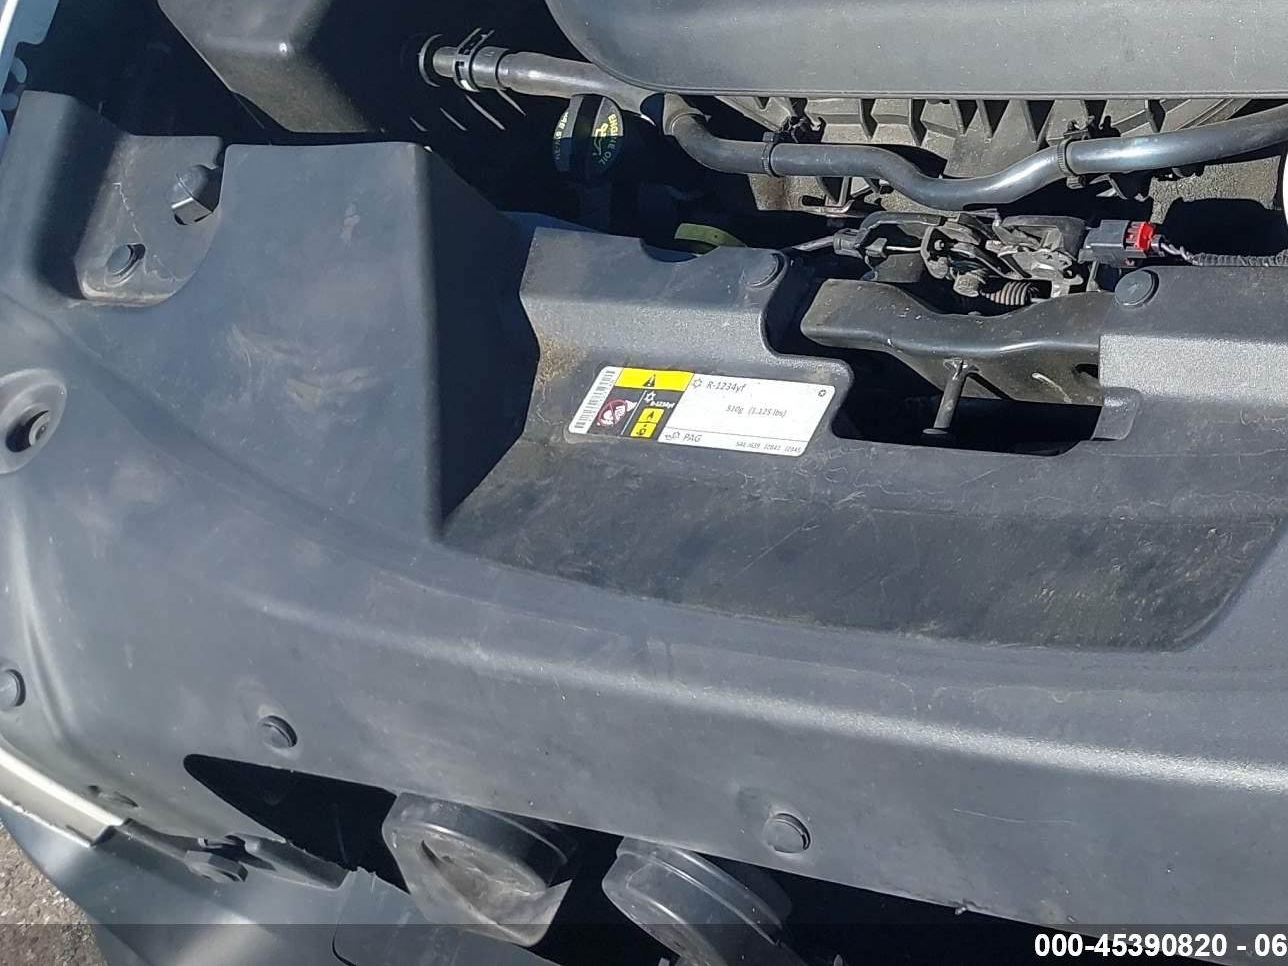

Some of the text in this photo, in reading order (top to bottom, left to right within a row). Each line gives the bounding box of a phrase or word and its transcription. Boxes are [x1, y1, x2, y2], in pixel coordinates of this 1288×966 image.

[599, 114, 619, 165] ENGINE OIL
[706, 380, 747, 393] R-1234yf
[683, 434, 703, 444] PAG
